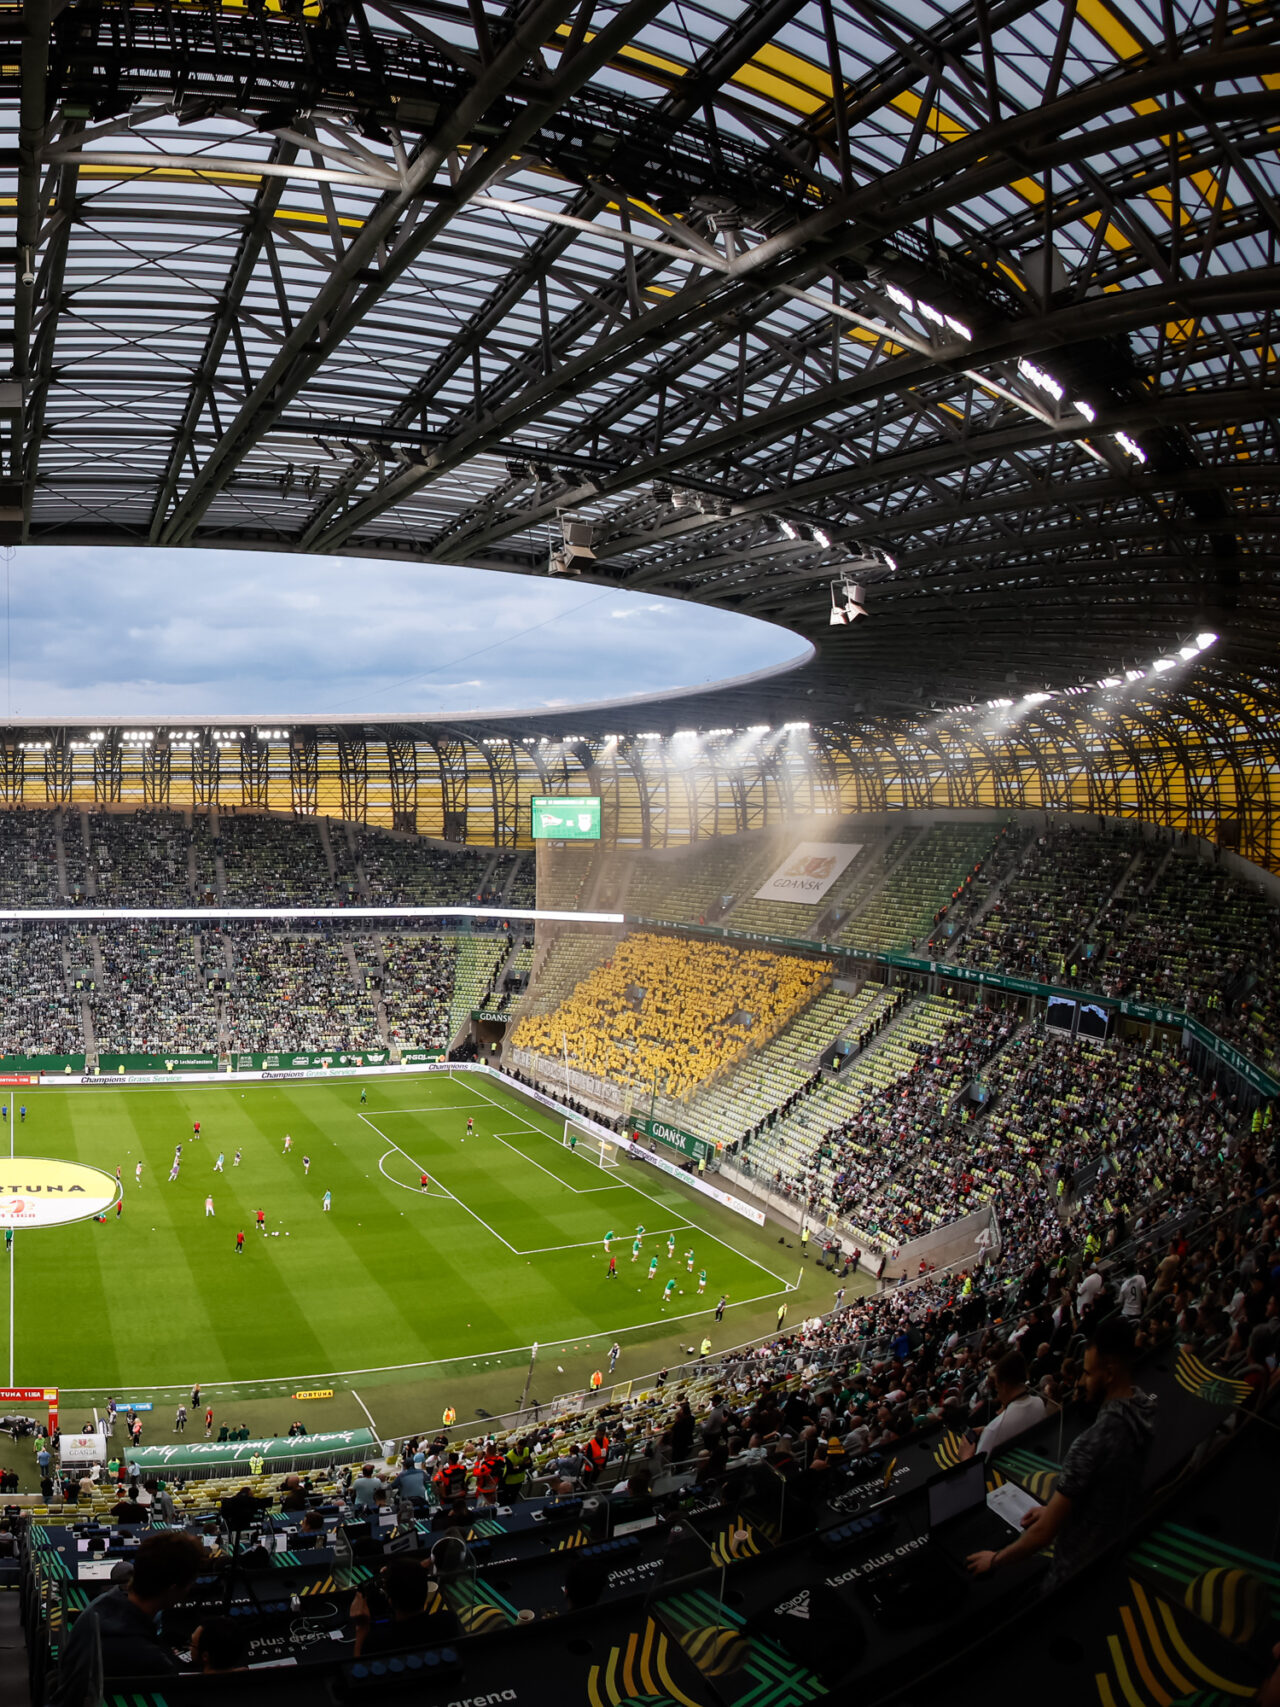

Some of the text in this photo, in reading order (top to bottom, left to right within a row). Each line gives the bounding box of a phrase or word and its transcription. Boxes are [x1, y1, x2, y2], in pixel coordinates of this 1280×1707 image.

[261, 1070, 304, 1079] Champions
[329, 1068, 356, 1076] Service
[428, 1063, 469, 1071] Champions
[81, 1074, 182, 1085] Champions Grass Service
[652, 1122, 687, 1149] GDAŃSK
[629, 1143, 696, 1185] Champions Grass Service
[974, 1228, 991, 1245] 4
[298, 1390, 333, 1398] FORTUNA
[142, 1445, 179, 1463] My
[186, 1441, 274, 1460] Tworzymy
[608, 1558, 664, 1582] plus aren
[824, 1568, 861, 1588] lsat
[609, 1571, 656, 1589] DAŃSK
[248, 1644, 308, 1657] DAŃSK
[249, 1634, 286, 1650] plus
[447, 1687, 518, 1707] arena
